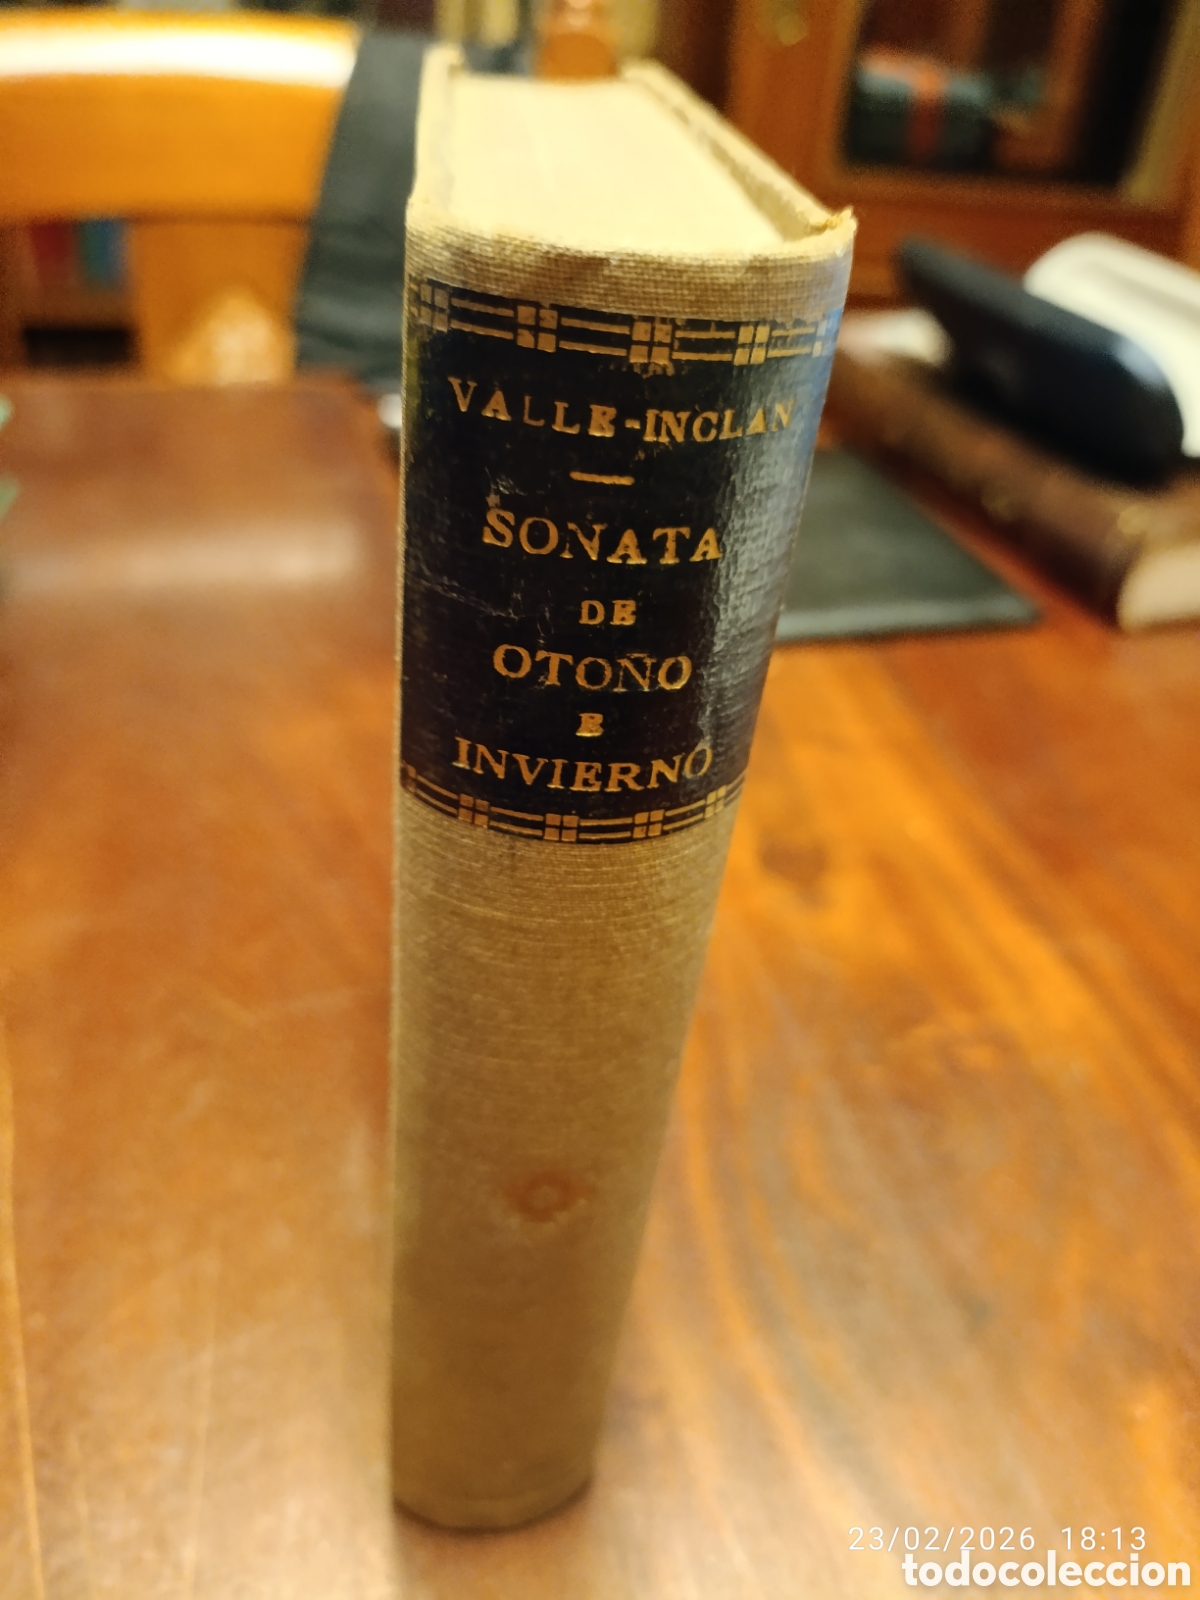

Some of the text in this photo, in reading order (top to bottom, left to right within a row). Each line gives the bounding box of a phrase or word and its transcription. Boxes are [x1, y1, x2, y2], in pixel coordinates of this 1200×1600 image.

[448, 376, 794, 443] VALLE-INCLAN
[482, 508, 722, 565] SONATA
[579, 599, 637, 625] DE
[493, 643, 693, 692] OTOÑO
[575, 713, 604, 737] E
[452, 738, 714, 792] INVIERNO
